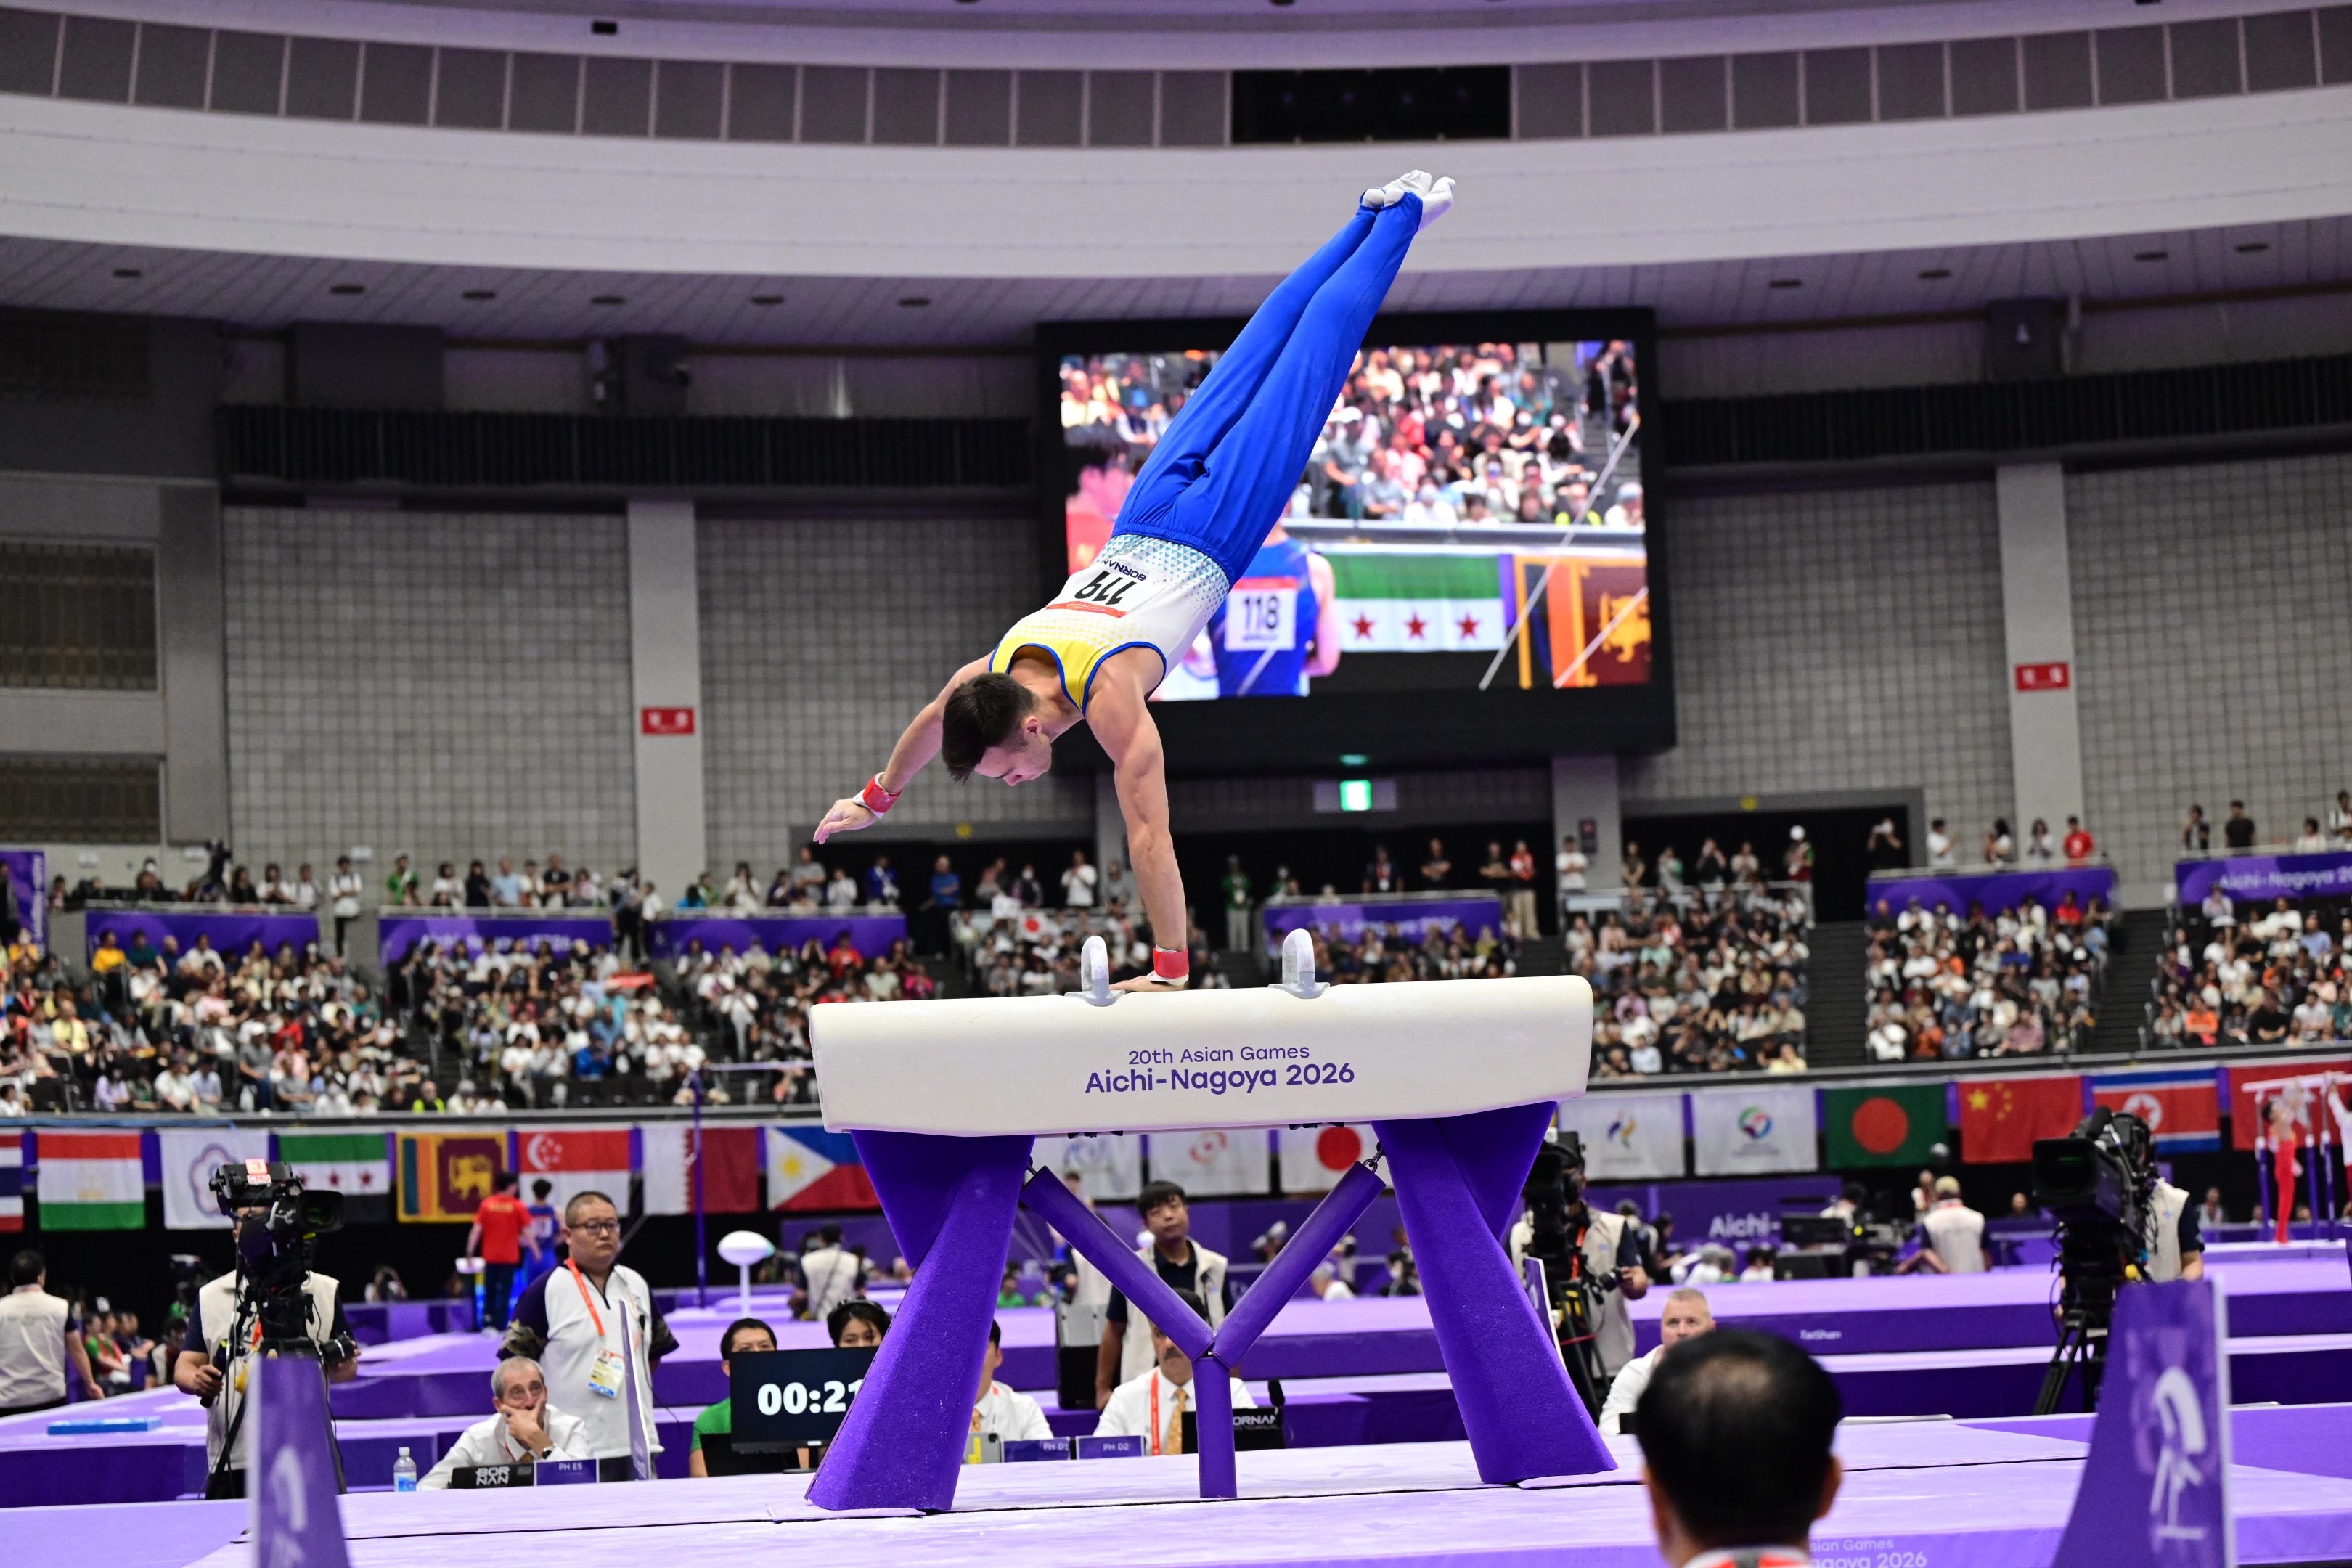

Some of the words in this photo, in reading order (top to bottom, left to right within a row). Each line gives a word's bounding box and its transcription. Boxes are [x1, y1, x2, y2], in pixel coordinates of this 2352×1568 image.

[1074, 570, 1137, 605] 119
[1244, 595, 1279, 629] 118
[1128, 1049, 1173, 1065] 20th
[1180, 1046, 1233, 1063] Asian
[1240, 1045, 1310, 1061] Games
[1085, 1067, 1277, 1095] Aichi-Nagoya
[1286, 1062, 1355, 1085] 2026
[1709, 1212, 1781, 1238] Aichi-
[1233, 1414, 1276, 1426] ORNA
[1103, 1442, 1115, 1451] PH
[476, 1466, 510, 1477] BOR
[558, 1463, 571, 1471] PH
[476, 1475, 509, 1486] NAN
[1809, 1540, 1839, 1552] sian
[1843, 1538, 1894, 1551] Games
[1877, 1551, 1927, 1568] 2026
